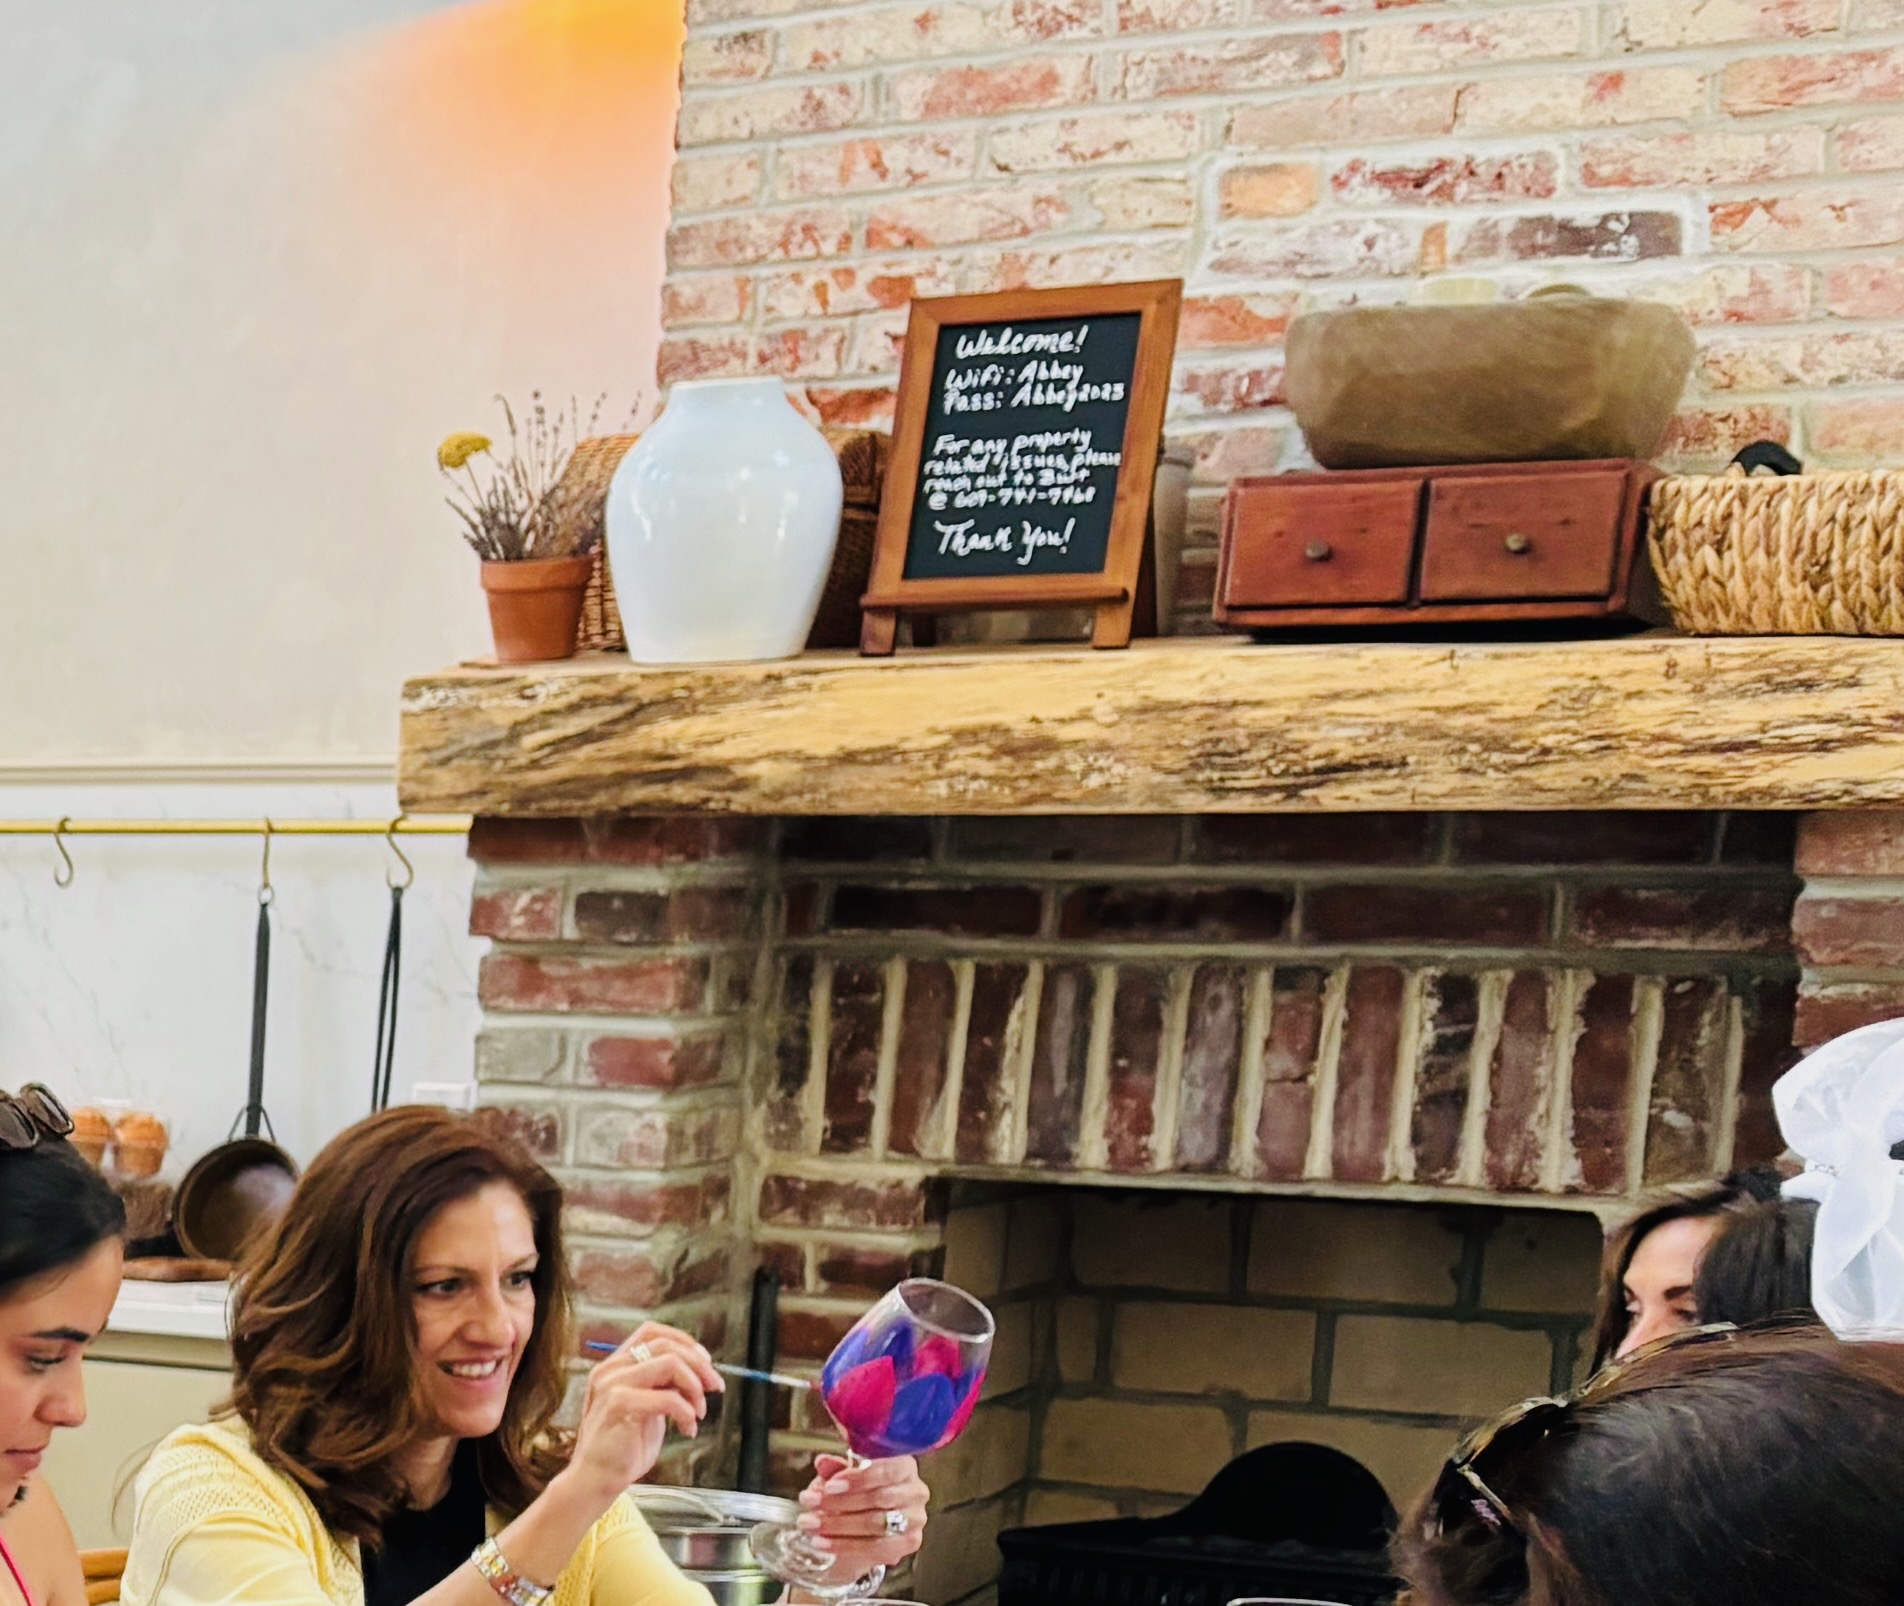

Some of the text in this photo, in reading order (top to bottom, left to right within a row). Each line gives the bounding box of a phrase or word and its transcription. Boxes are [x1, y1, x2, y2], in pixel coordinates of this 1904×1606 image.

[956, 325, 1088, 359] Welcome!
[1017, 360, 1084, 390] Abbey
[1011, 427, 1092, 457] property
[928, 491, 948, 510] @
[933, 517, 1076, 565] Thank You!
